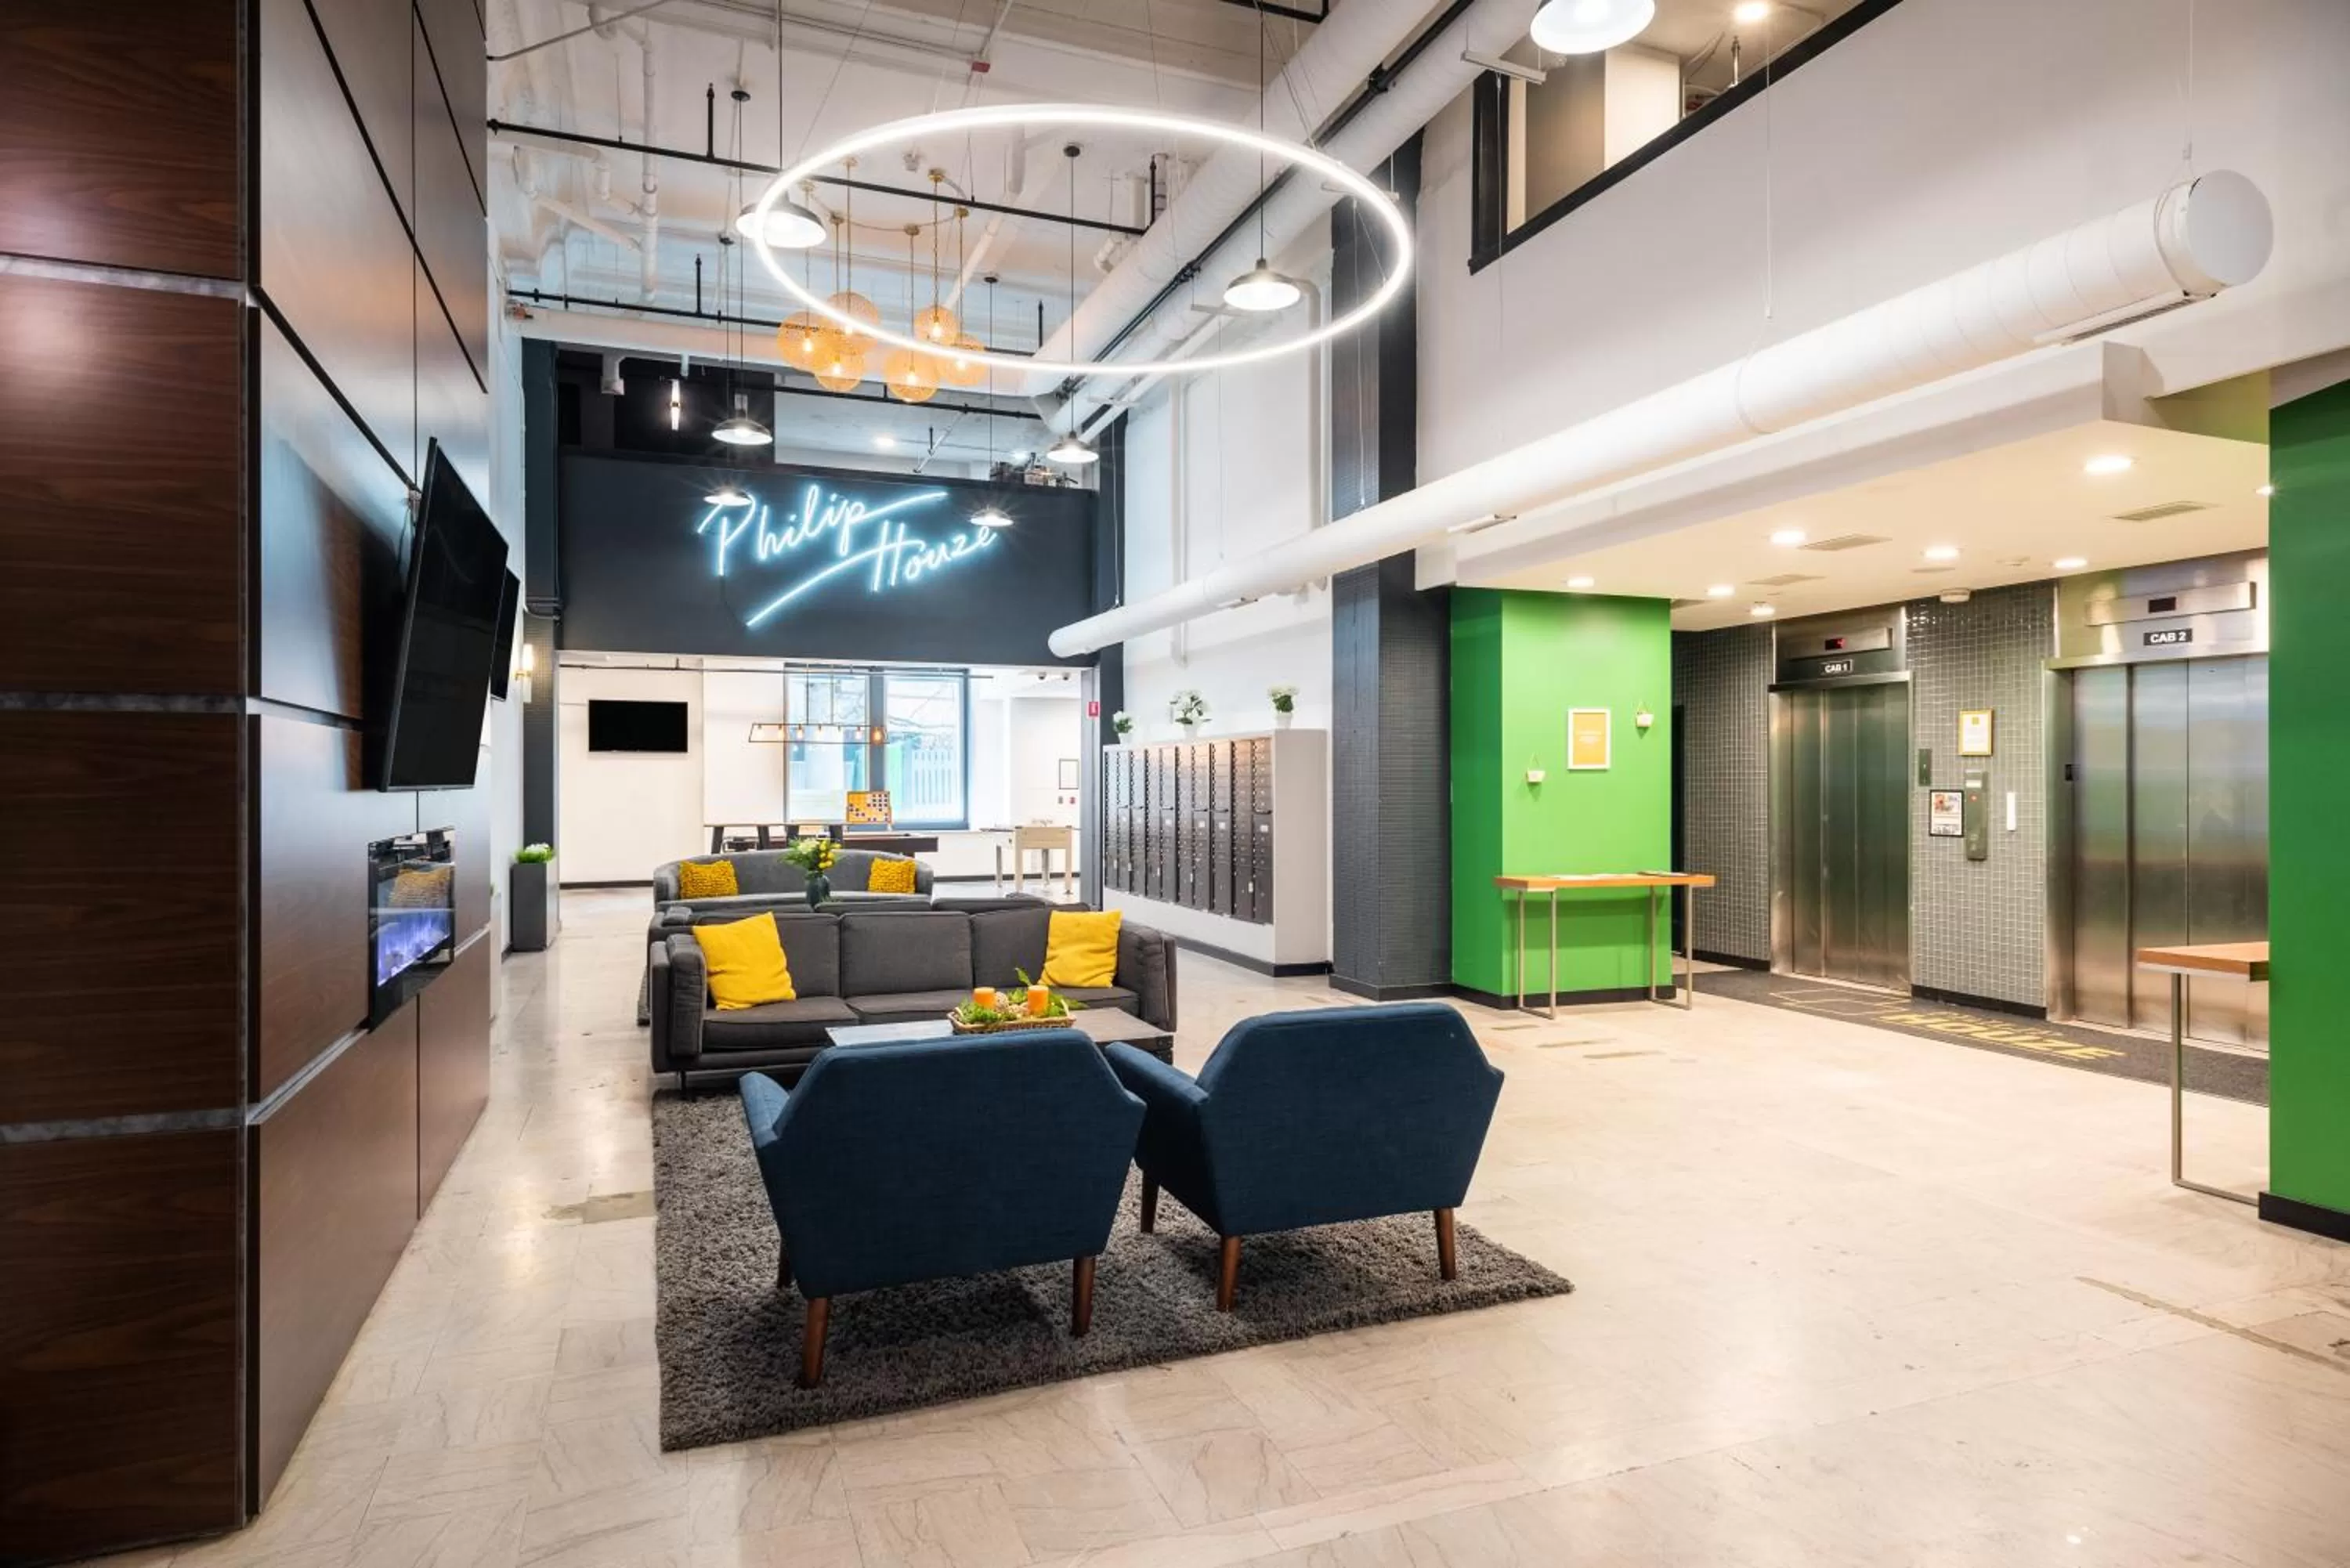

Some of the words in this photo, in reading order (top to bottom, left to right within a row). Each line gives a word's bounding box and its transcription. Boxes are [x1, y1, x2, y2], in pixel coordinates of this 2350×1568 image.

[697, 485, 948, 576] Philip
[2150, 633, 2176, 642] CAB
[2178, 631, 2186, 641] 2
[1824, 663, 1842, 674] CAB
[1878, 1014, 2125, 1059] HOUZE
